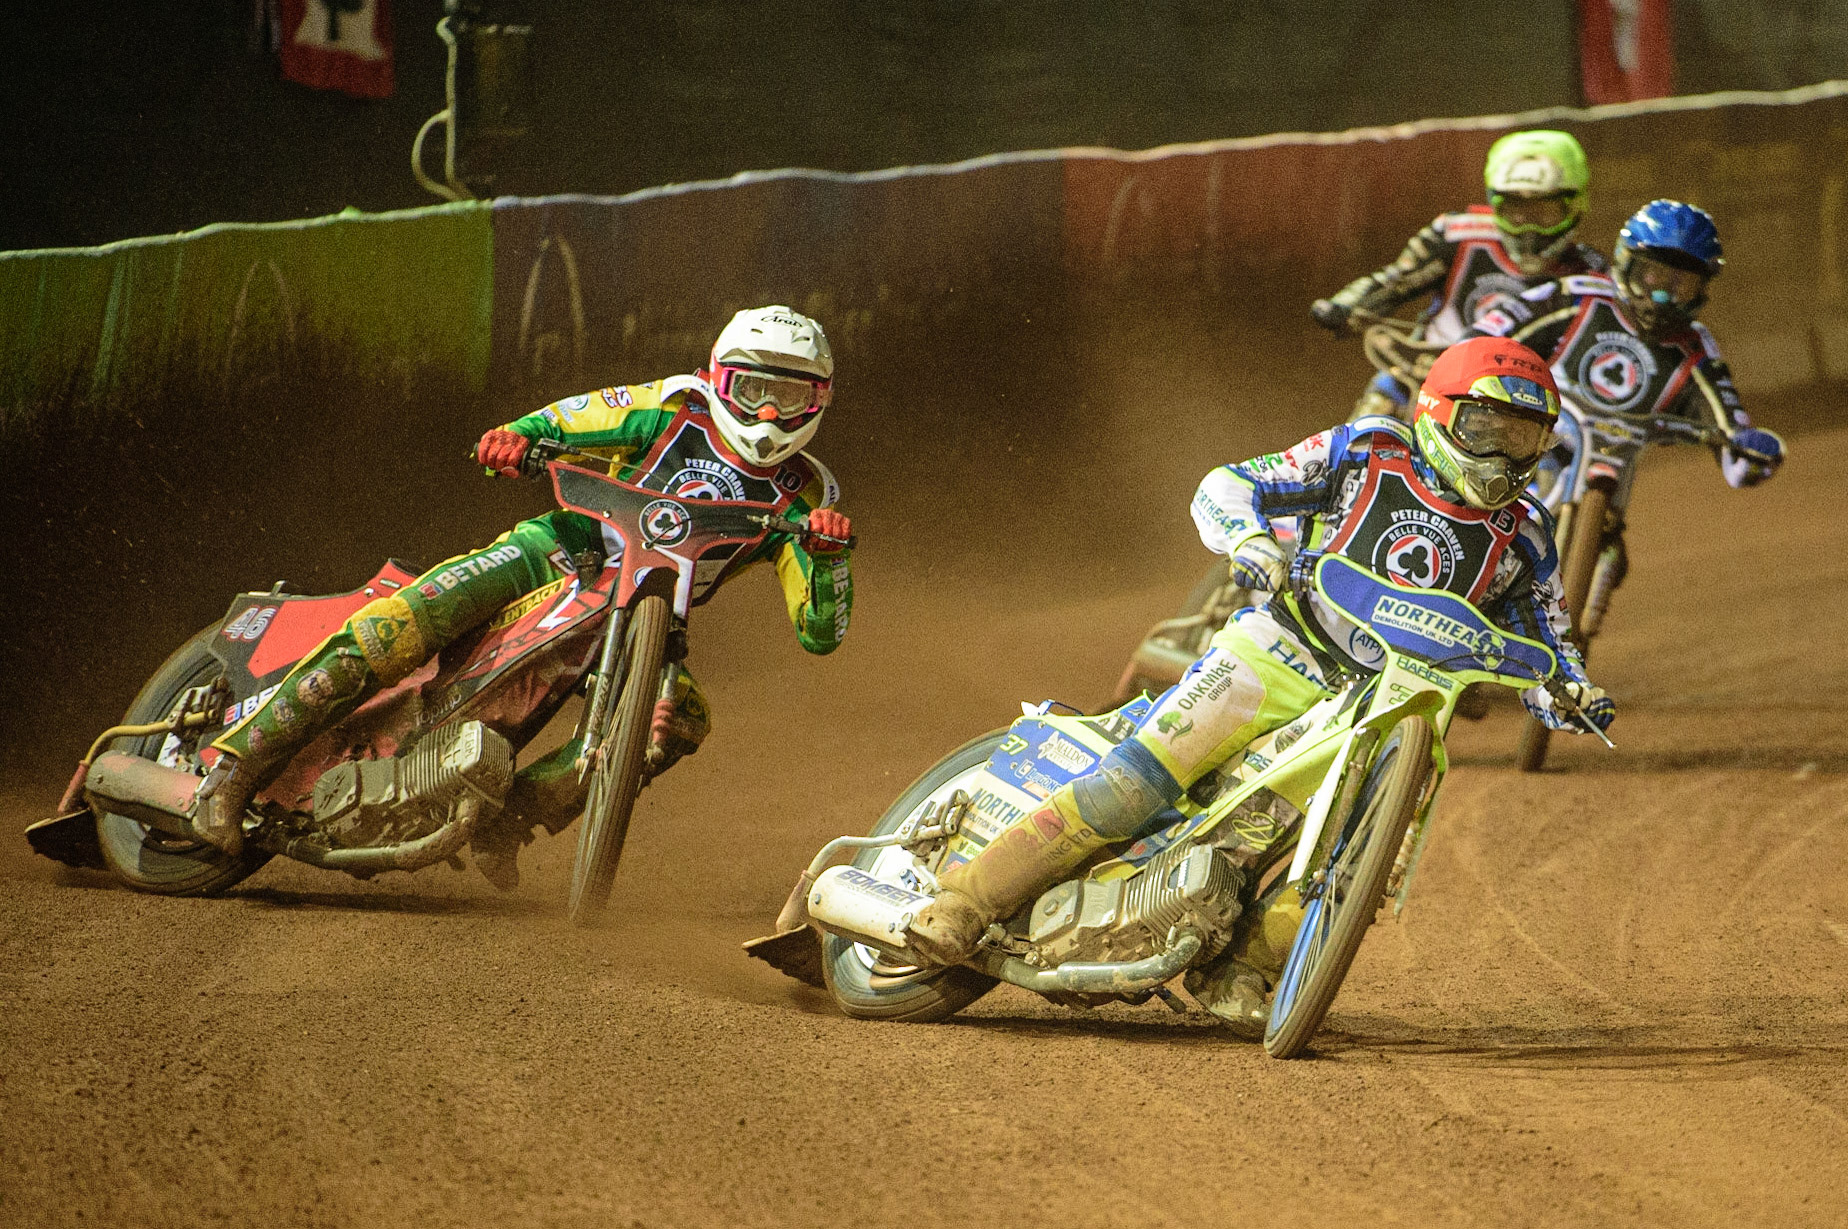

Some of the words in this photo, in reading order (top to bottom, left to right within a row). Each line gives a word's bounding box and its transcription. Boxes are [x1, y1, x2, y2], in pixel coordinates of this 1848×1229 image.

[678, 472, 708, 483] BELLE
[712, 477, 726, 489] VUE
[685, 458, 721, 473] PETER
[721, 465, 746, 501] CRAVE
[773, 465, 802, 493] 10
[645, 502, 662, 517] BELLE
[663, 502, 675, 510] VUE
[1388, 525, 1418, 542] BELLE
[1423, 527, 1441, 544] VUE
[1439, 546, 1450, 574] ACES
[1390, 509, 1428, 523] PETER
[1430, 515, 1466, 561] CRAVEN
[436, 544, 522, 590] BETARD
[221, 605, 277, 641] 46
[1374, 614, 1423, 633] DEMOLITION
[1425, 629, 1437, 639] UK
[1438, 635, 1452, 645] LTD
[1208, 676, 1234, 702] GROUP
[1397, 656, 1454, 690] HARRIS
[1000, 733, 1029, 756] 37
[970, 788, 1025, 826] NORTH
[836, 869, 925, 904] BOMBER
